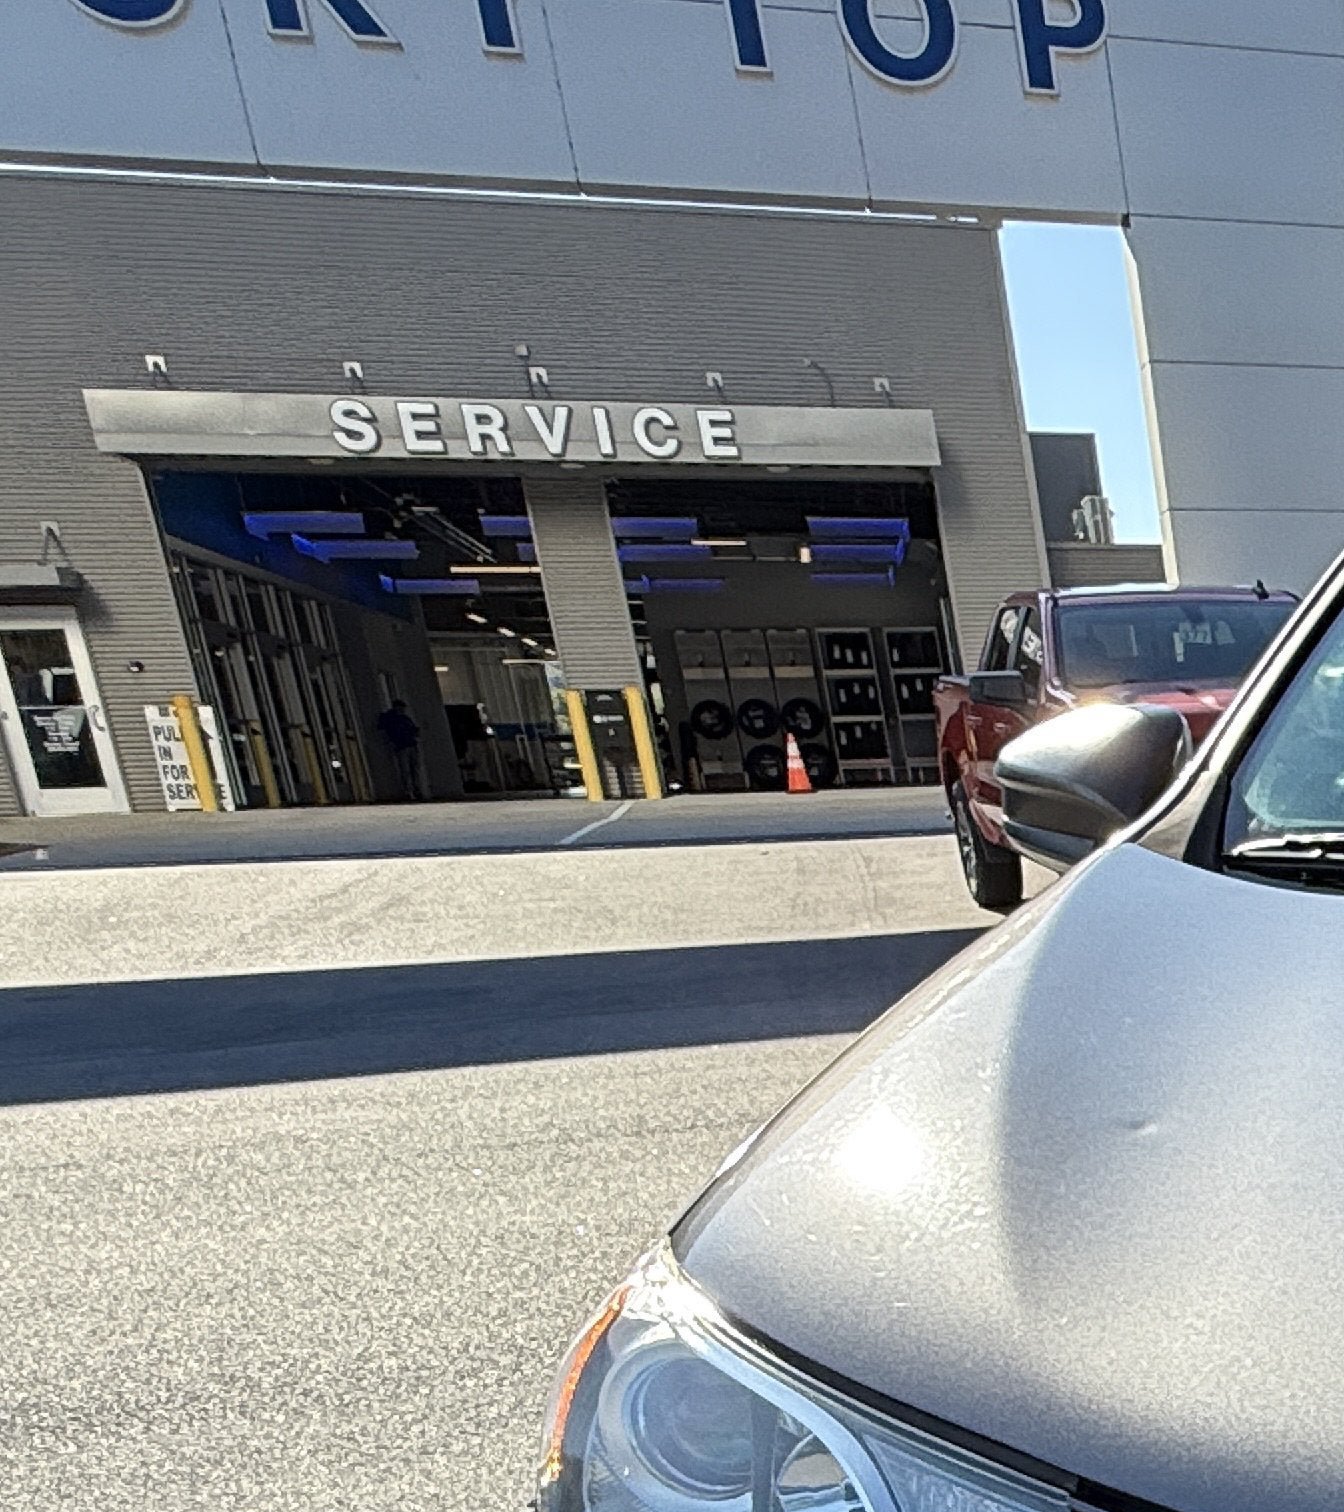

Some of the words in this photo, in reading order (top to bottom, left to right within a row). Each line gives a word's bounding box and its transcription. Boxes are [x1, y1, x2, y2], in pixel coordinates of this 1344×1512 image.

[330, 399, 742, 460] SERVICE
[153, 724, 183, 742] PUL
[158, 744, 174, 762] IN
[162, 764, 190, 781] FOR
[166, 782, 228, 801] SERE
